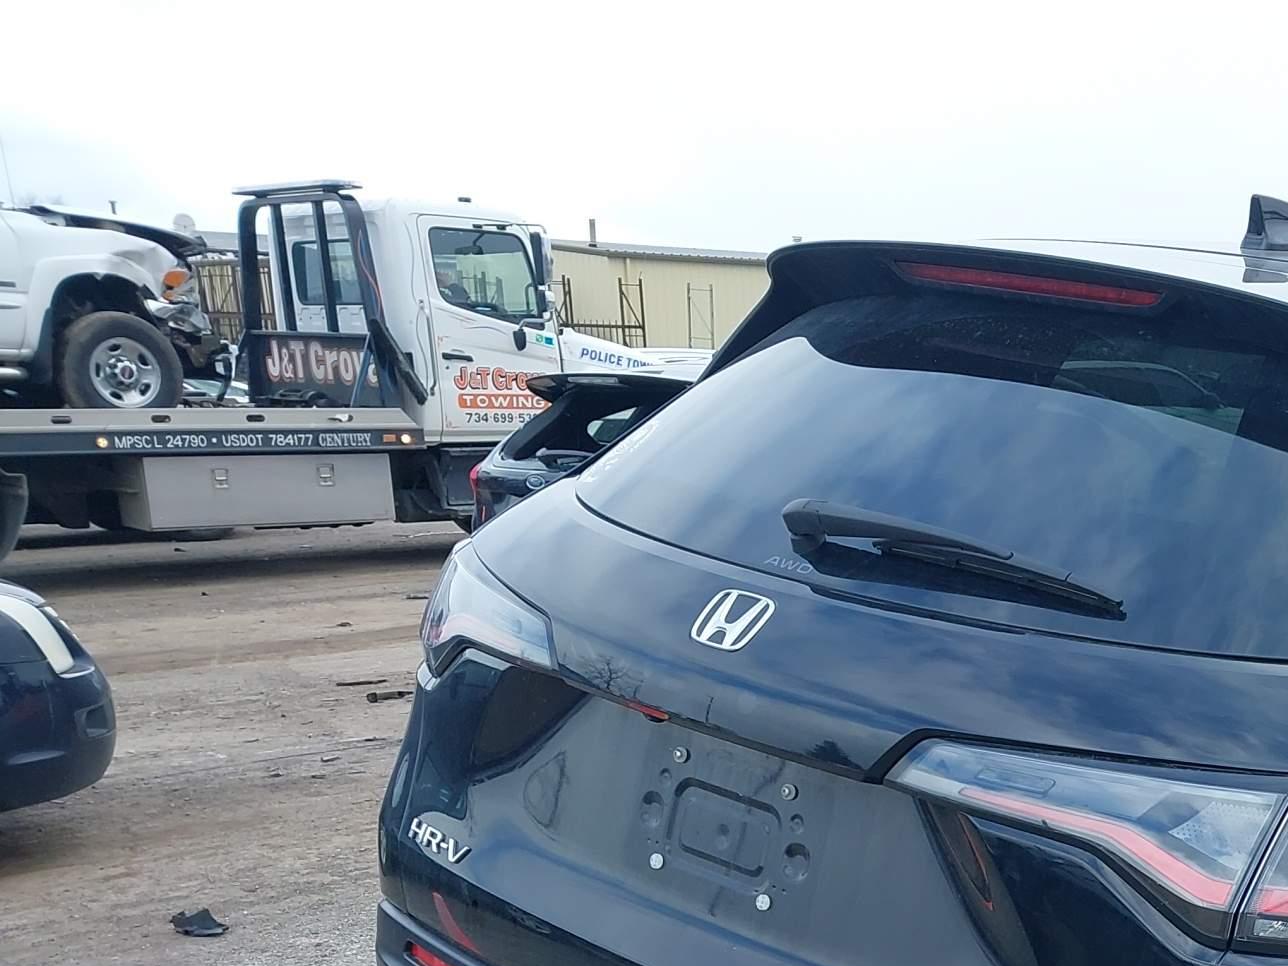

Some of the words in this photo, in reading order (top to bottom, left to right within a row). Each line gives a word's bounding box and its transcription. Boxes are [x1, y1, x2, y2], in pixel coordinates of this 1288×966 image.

[266, 339, 305, 382] J&T
[580, 347, 624, 367] POLICE
[454, 366, 490, 389] J&T
[462, 394, 545, 408] TOWING
[114, 435, 152, 448] MPSC
[165, 434, 208, 448] 24790
[222, 433, 263, 447] USDOT
[268, 433, 313, 447] 784177
[318, 432, 372, 447] CENTURY
[764, 555, 813, 574] AWD
[408, 817, 472, 864] HR-V
